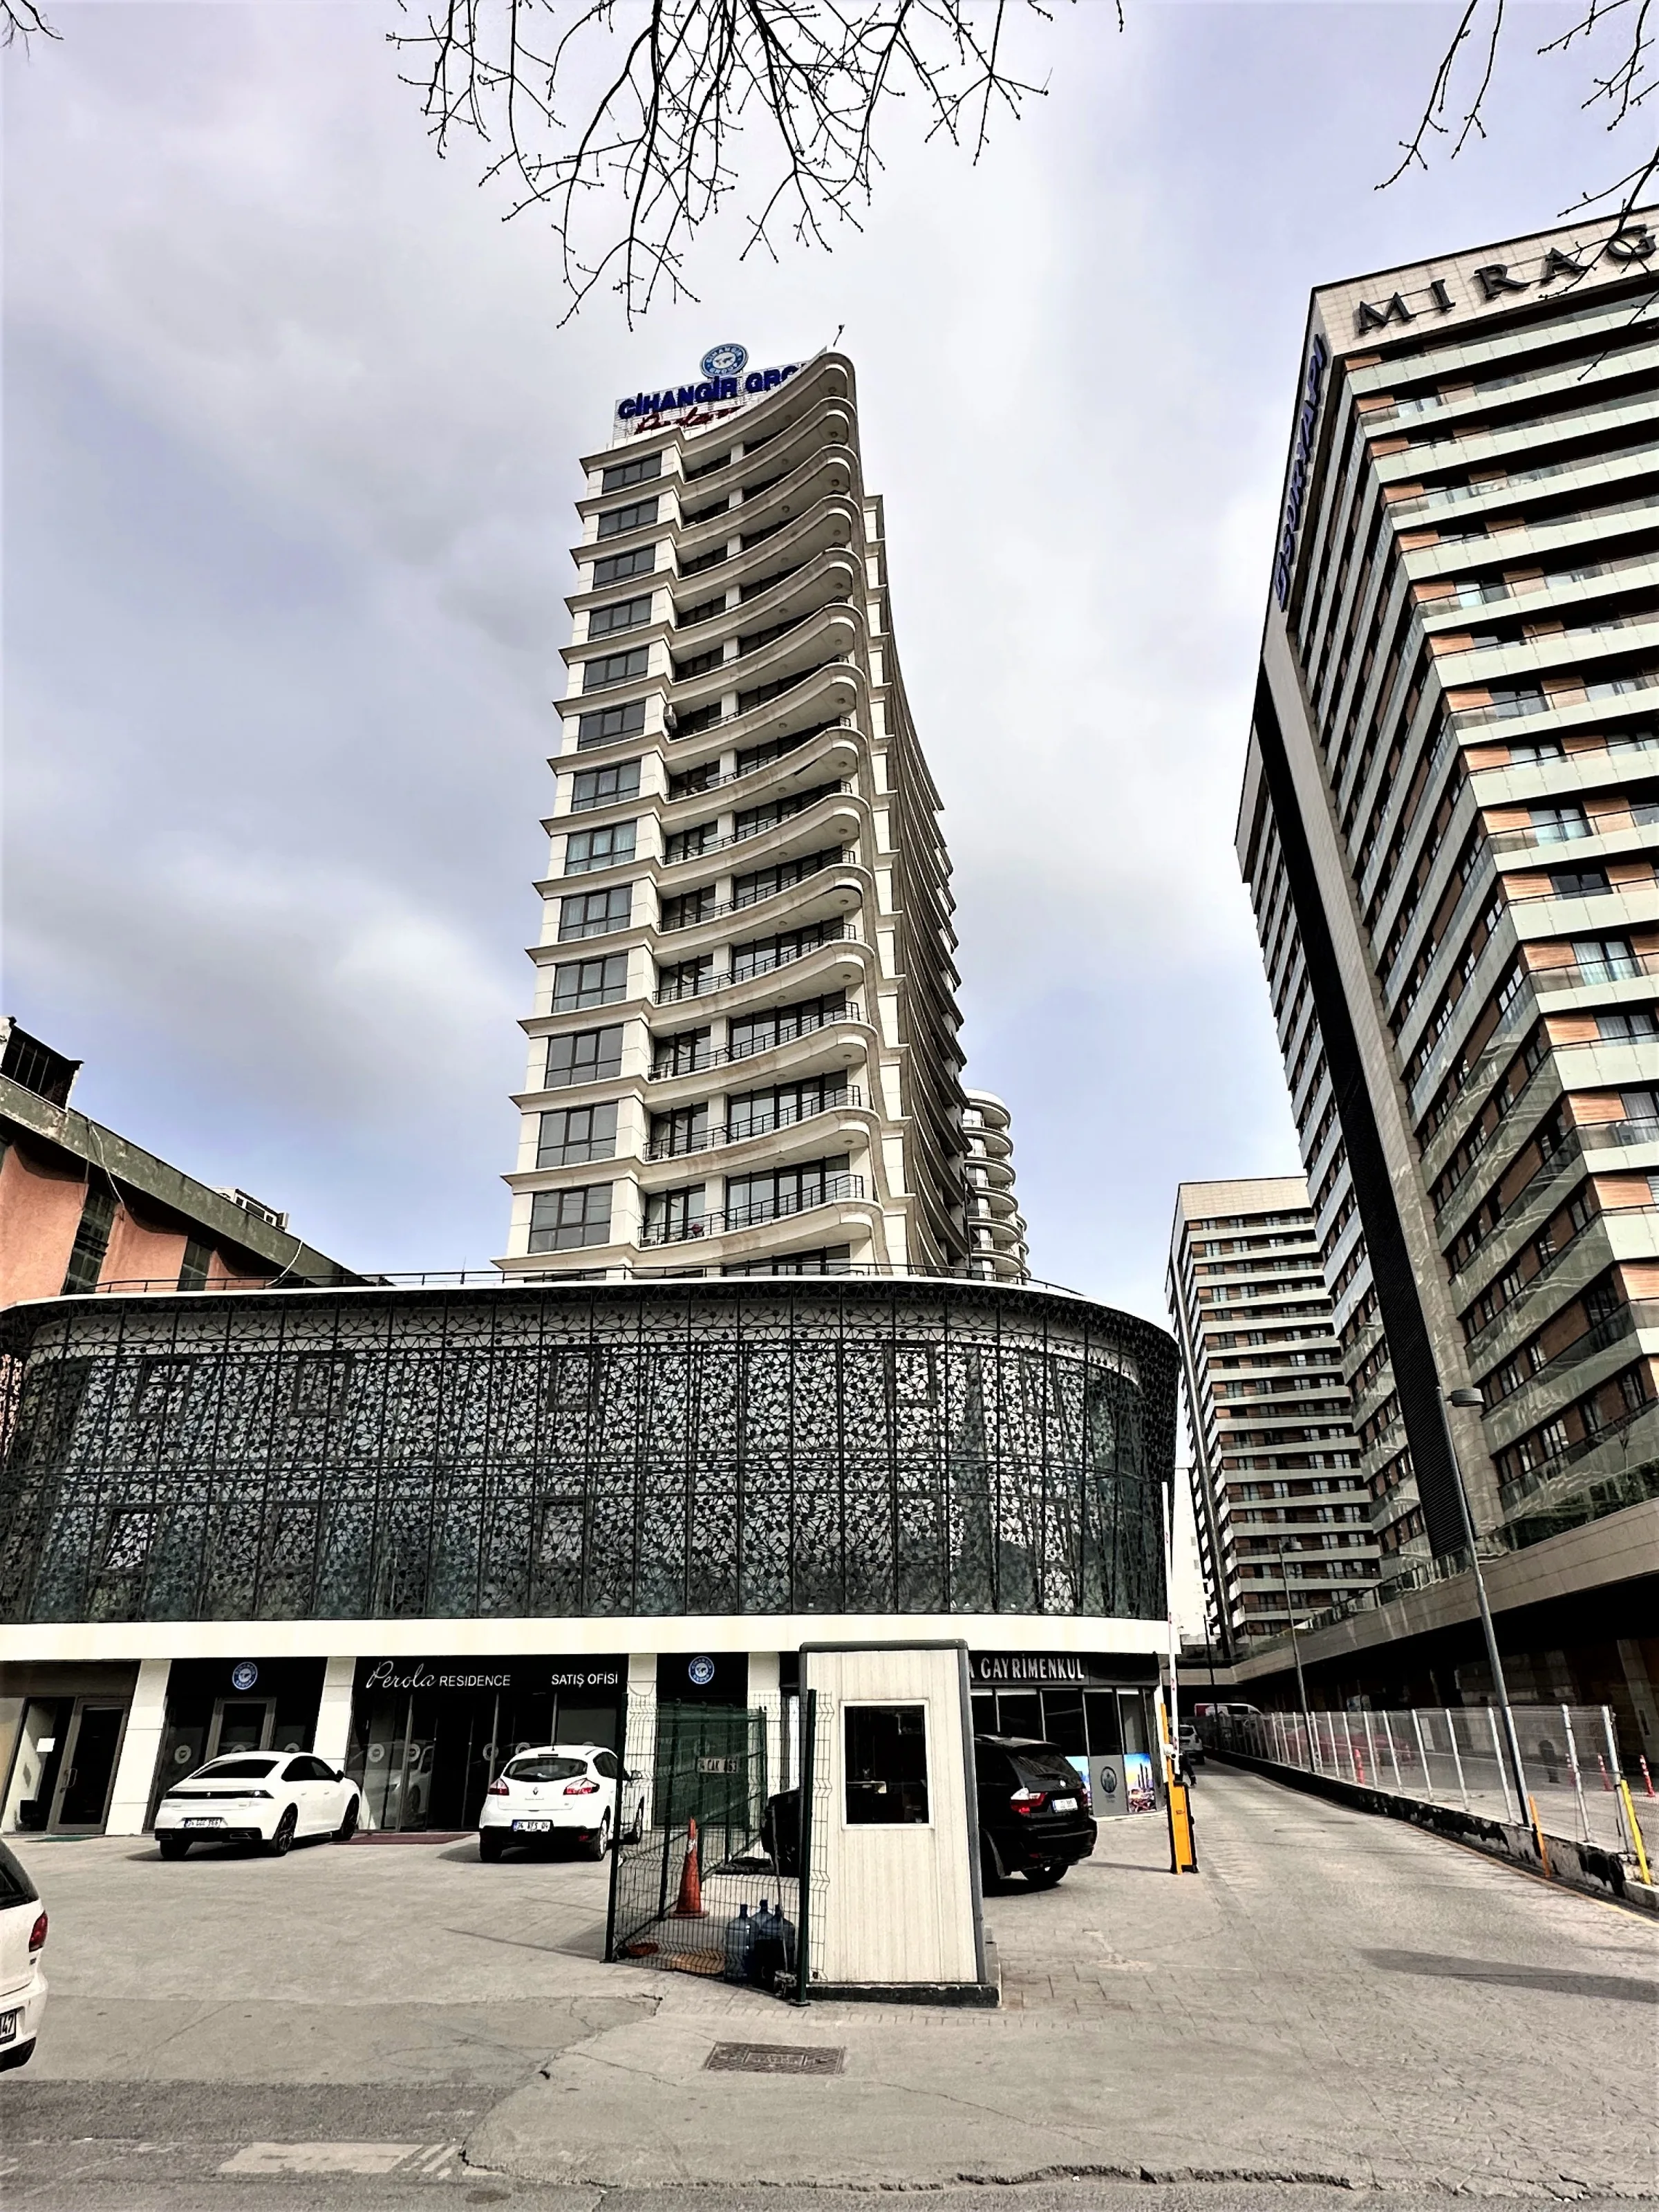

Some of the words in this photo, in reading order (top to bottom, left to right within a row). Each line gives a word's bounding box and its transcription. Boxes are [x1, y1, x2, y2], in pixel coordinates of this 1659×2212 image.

[745, 362, 807, 393] GRO
[366, 1660, 437, 1688] Perola
[439, 1674, 512, 1687] RESIDENCE
[980, 1653, 1085, 1679] GAYRİMENKUL
[551, 1673, 585, 1688] SATIŞ
[587, 1671, 618, 1685] OFİSİ
[0, 2013, 15, 2034] 47
